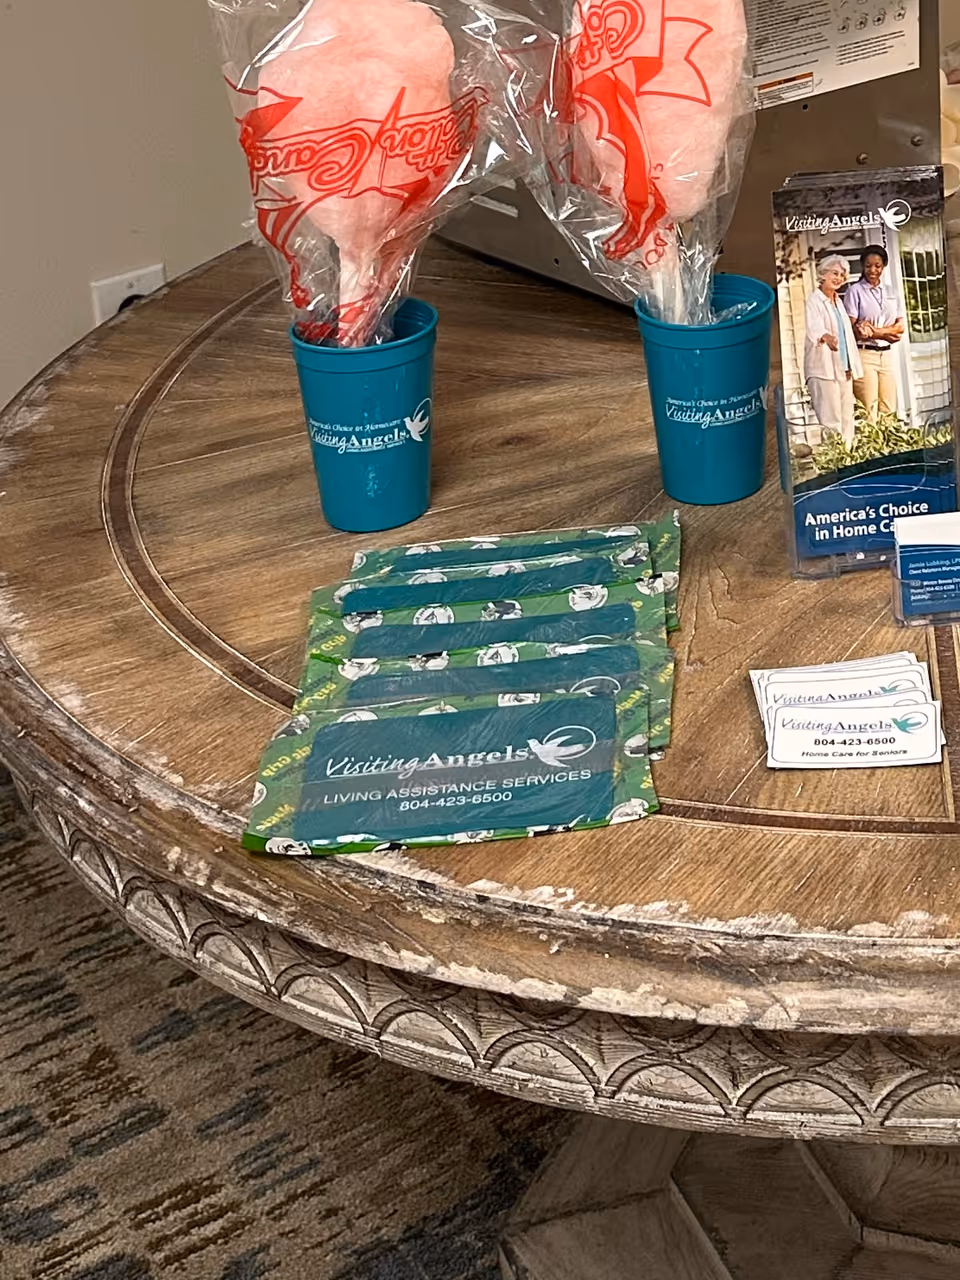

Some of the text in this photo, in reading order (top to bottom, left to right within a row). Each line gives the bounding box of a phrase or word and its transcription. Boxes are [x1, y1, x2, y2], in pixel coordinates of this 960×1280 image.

[831, 211, 881, 227] Angels
[346, 428, 406, 448] Angels
[805, 501, 929, 526] America's Choice
[815, 520, 896, 541] in Home Ca
[782, 717, 833, 736] Visiting
[832, 721, 893, 734] Angels
[814, 736, 896, 746] 804-423-6500
[326, 755, 421, 780] Visiting
[423, 745, 530, 769] Angels
[323, 791, 382, 804] LIVING
[385, 780, 497, 801] ASSISTANCE
[502, 769, 593, 790] SERVICES
[400, 791, 513, 812] 804-423-6500
